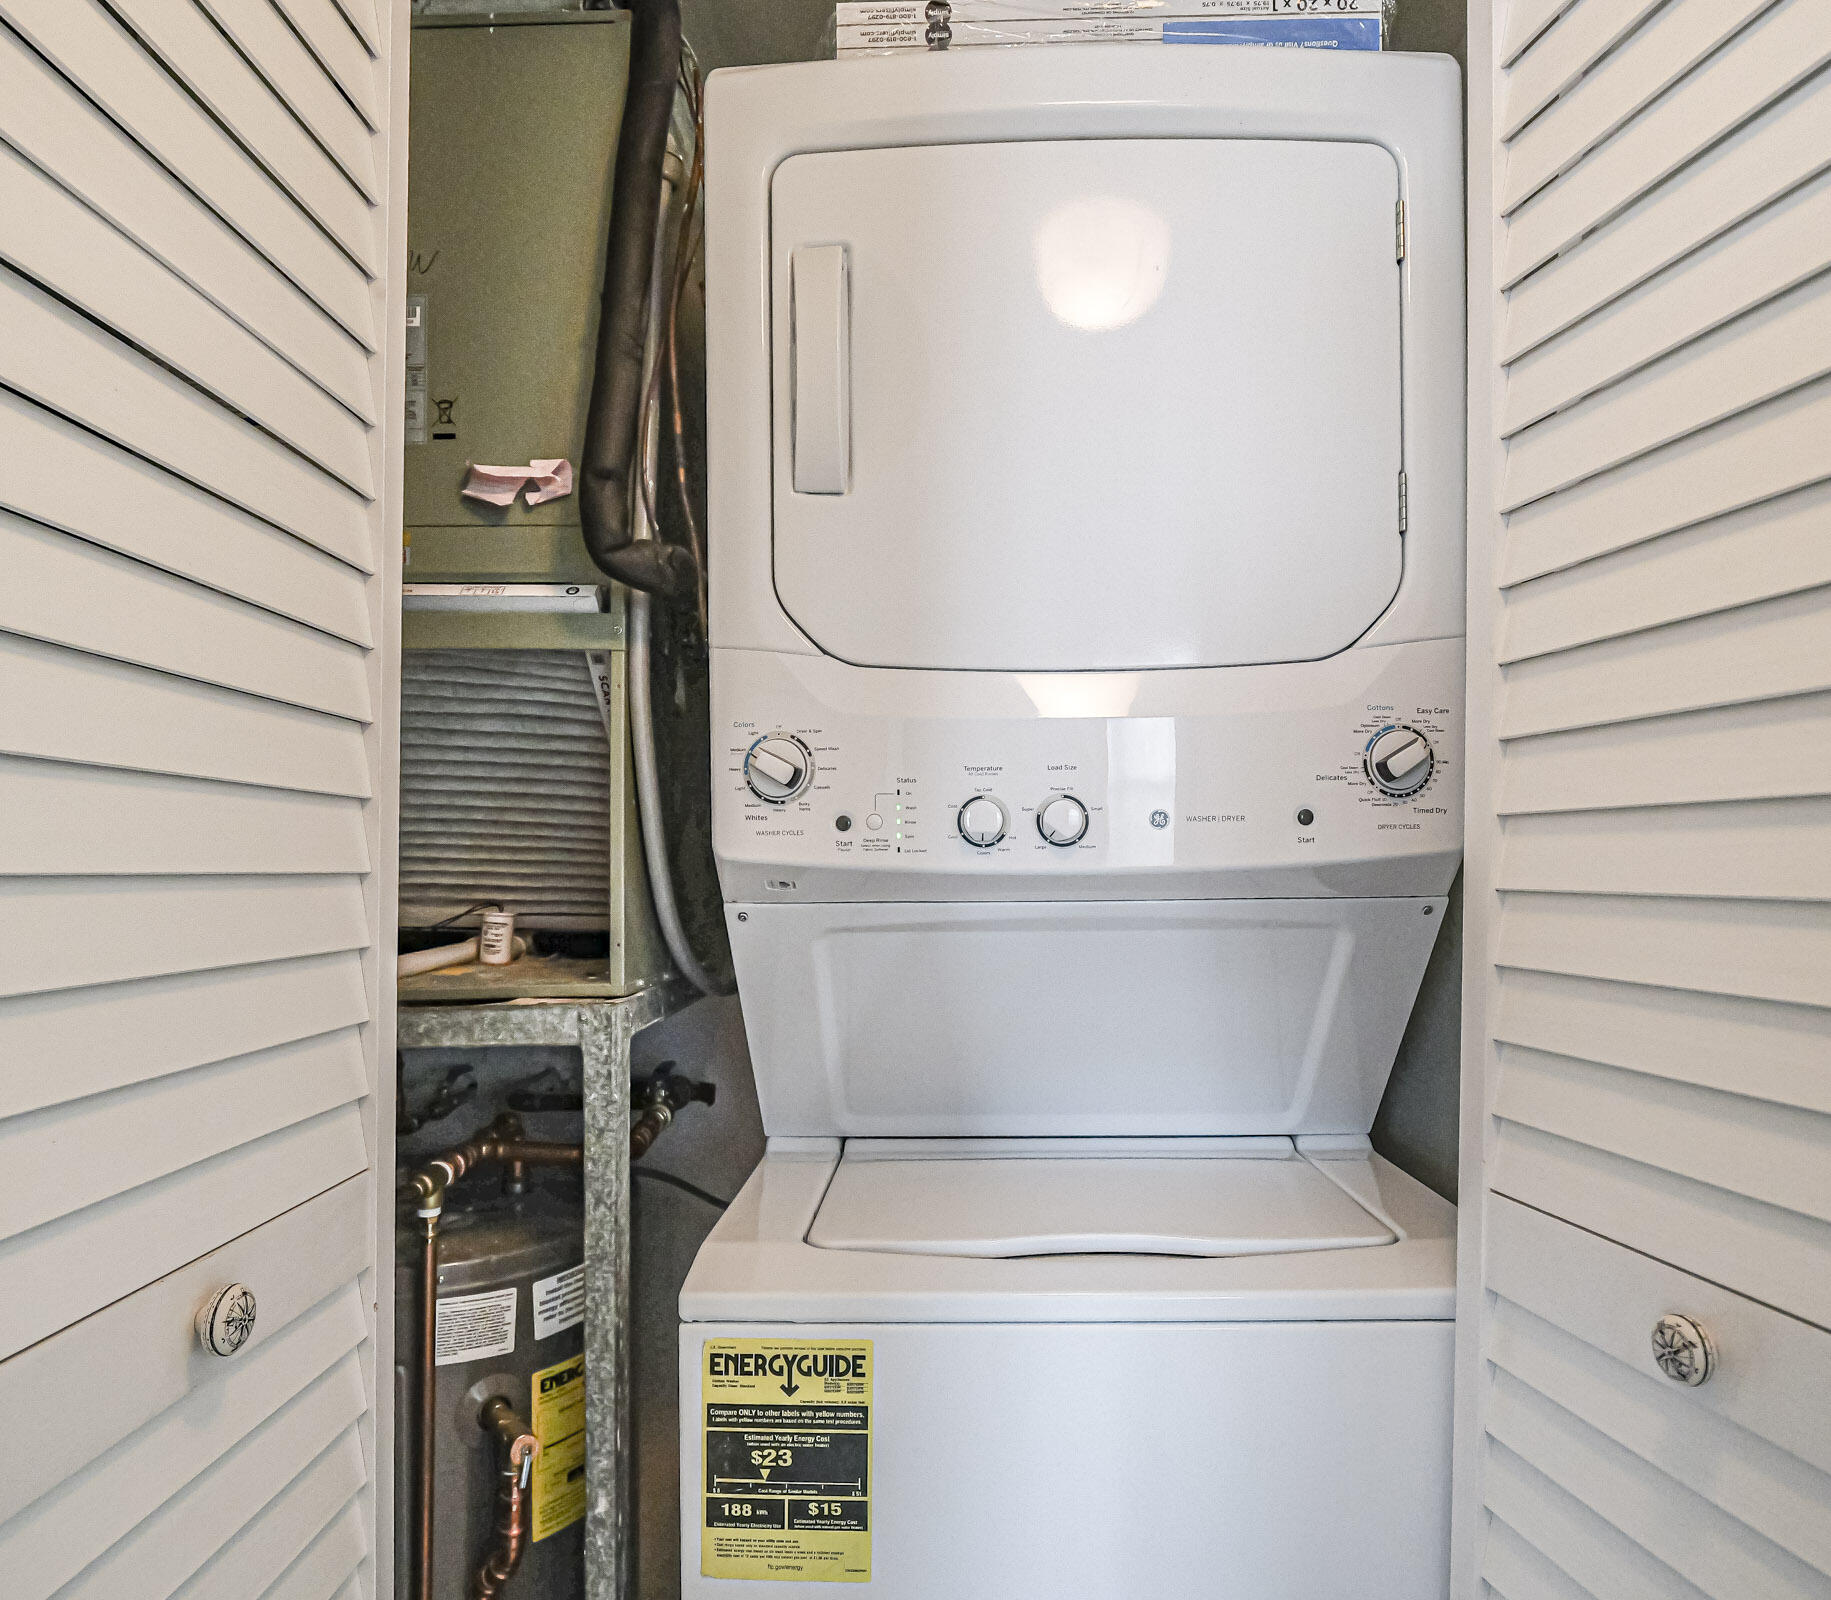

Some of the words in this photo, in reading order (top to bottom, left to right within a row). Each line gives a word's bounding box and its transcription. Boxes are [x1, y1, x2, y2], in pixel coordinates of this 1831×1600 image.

[1416, 707, 1432, 715] Easy
[1435, 807, 1448, 815] Dry
[1297, 836, 1315, 844] Start
[709, 1353, 866, 1378] ENERGYGUIDE
[710, 1408, 738, 1418] Compare
[738, 1408, 756, 1417] ONLY
[757, 1409, 764, 1417] to
[764, 1409, 780, 1417] other
[781, 1409, 800, 1418] labels
[800, 1410, 814, 1418] with
[815, 1410, 835, 1420] yellow
[836, 1411, 865, 1419] numbers.
[738, 1417, 753, 1425] yellow
[744, 1434, 774, 1442] Estimated
[774, 1435, 793, 1443] Yearly
[793, 1435, 815, 1444] Energy
[815, 1435, 830, 1443] Cost
[750, 1449, 793, 1467] $23
[720, 1503, 752, 1517] 188
[807, 1502, 843, 1517] $15
[830, 1520, 847, 1528] Energy
